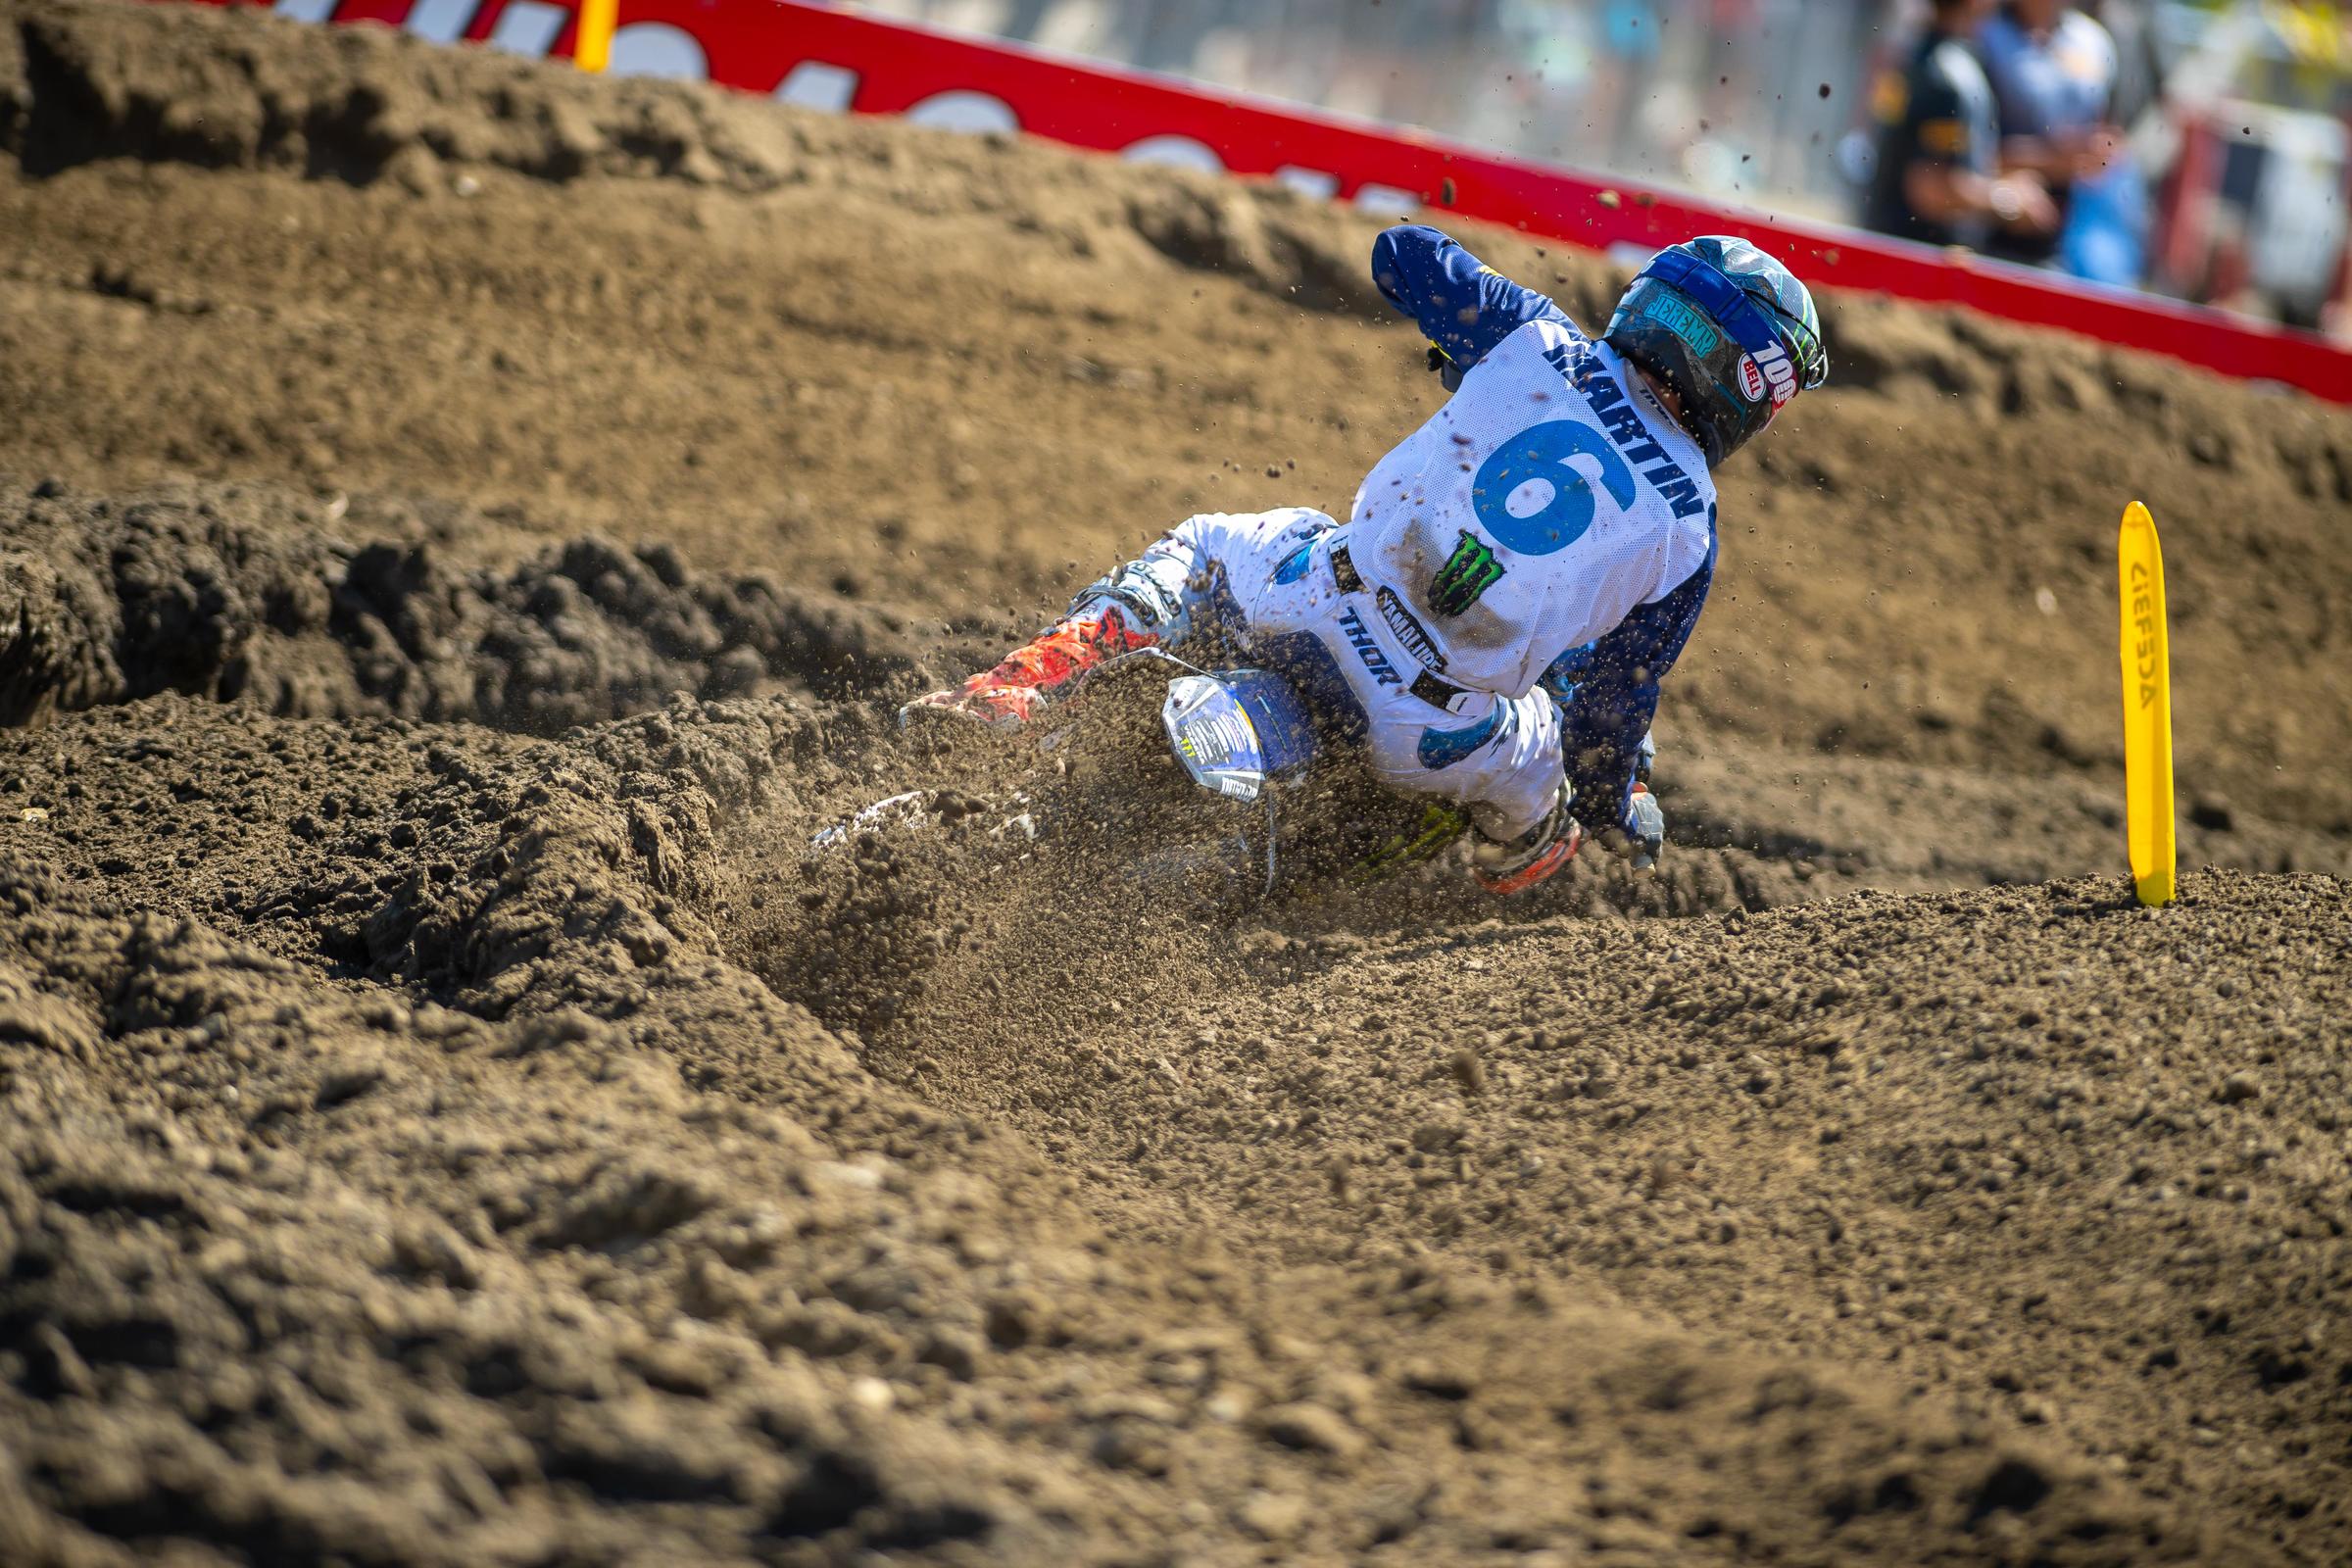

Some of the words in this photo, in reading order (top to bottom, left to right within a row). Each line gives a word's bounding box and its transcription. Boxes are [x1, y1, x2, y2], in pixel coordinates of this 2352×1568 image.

[1644, 295, 1717, 359] JEREMY
[1742, 359, 1763, 397] BELL
[1542, 343, 1704, 519] MARTIN
[1472, 418, 1637, 556] 6
[1339, 606, 1403, 687] THOR
